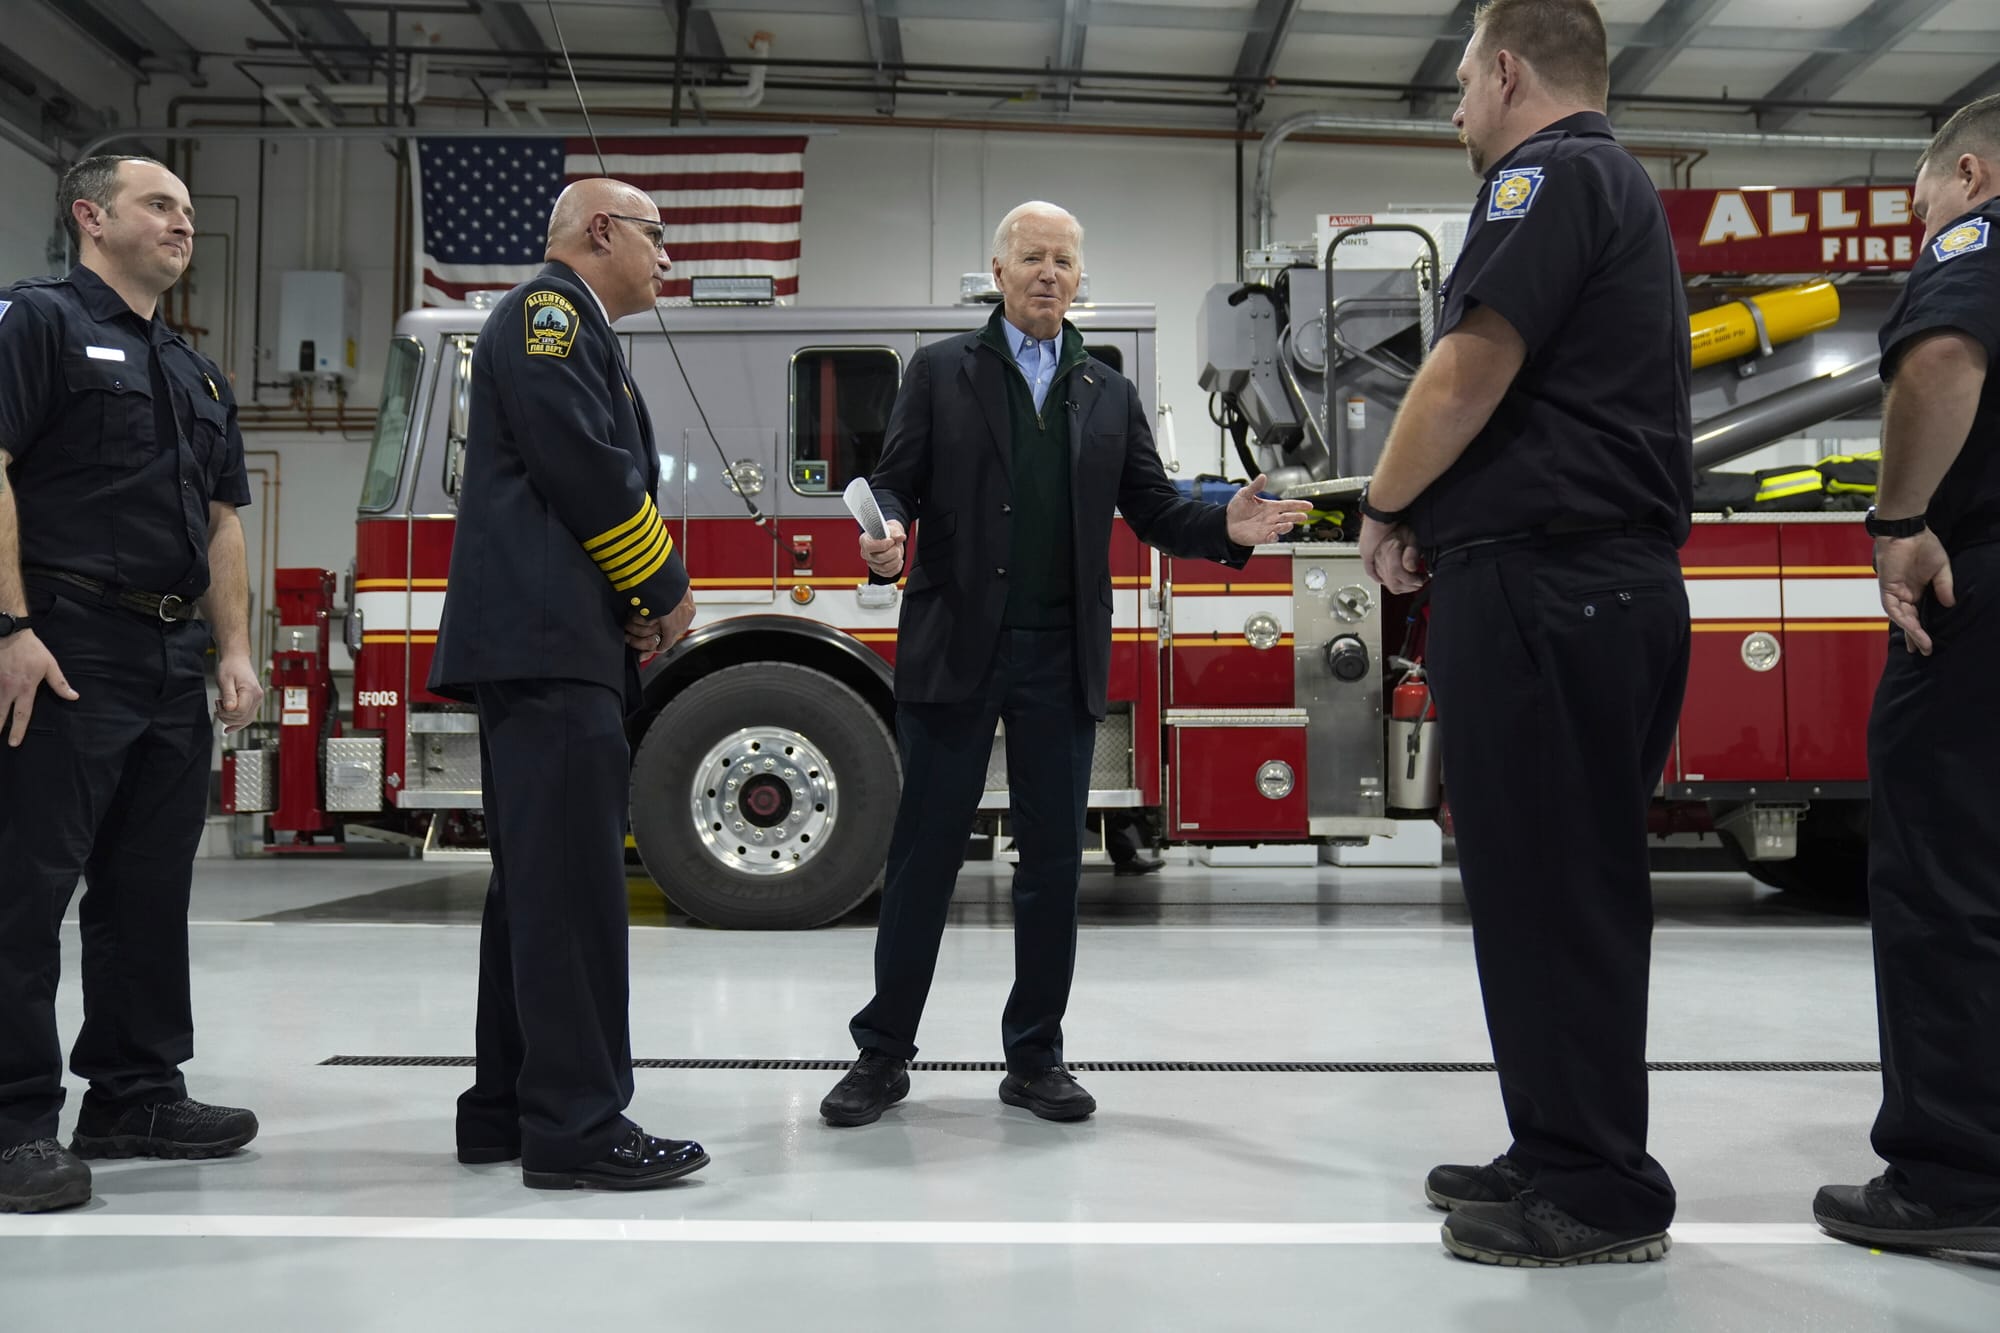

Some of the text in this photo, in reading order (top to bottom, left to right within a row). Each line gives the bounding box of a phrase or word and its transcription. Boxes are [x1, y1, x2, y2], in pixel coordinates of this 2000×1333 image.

[1339, 216, 1370, 225] DANGER
[1699, 190, 1912, 246] ALLE
[1340, 238, 1369, 246] OINTS
[1822, 236, 1912, 262] FIRE
[528, 293, 578, 316] ALLENTOWN
[530, 344, 544, 352] FIRE
[358, 691, 398, 706] 5F003
